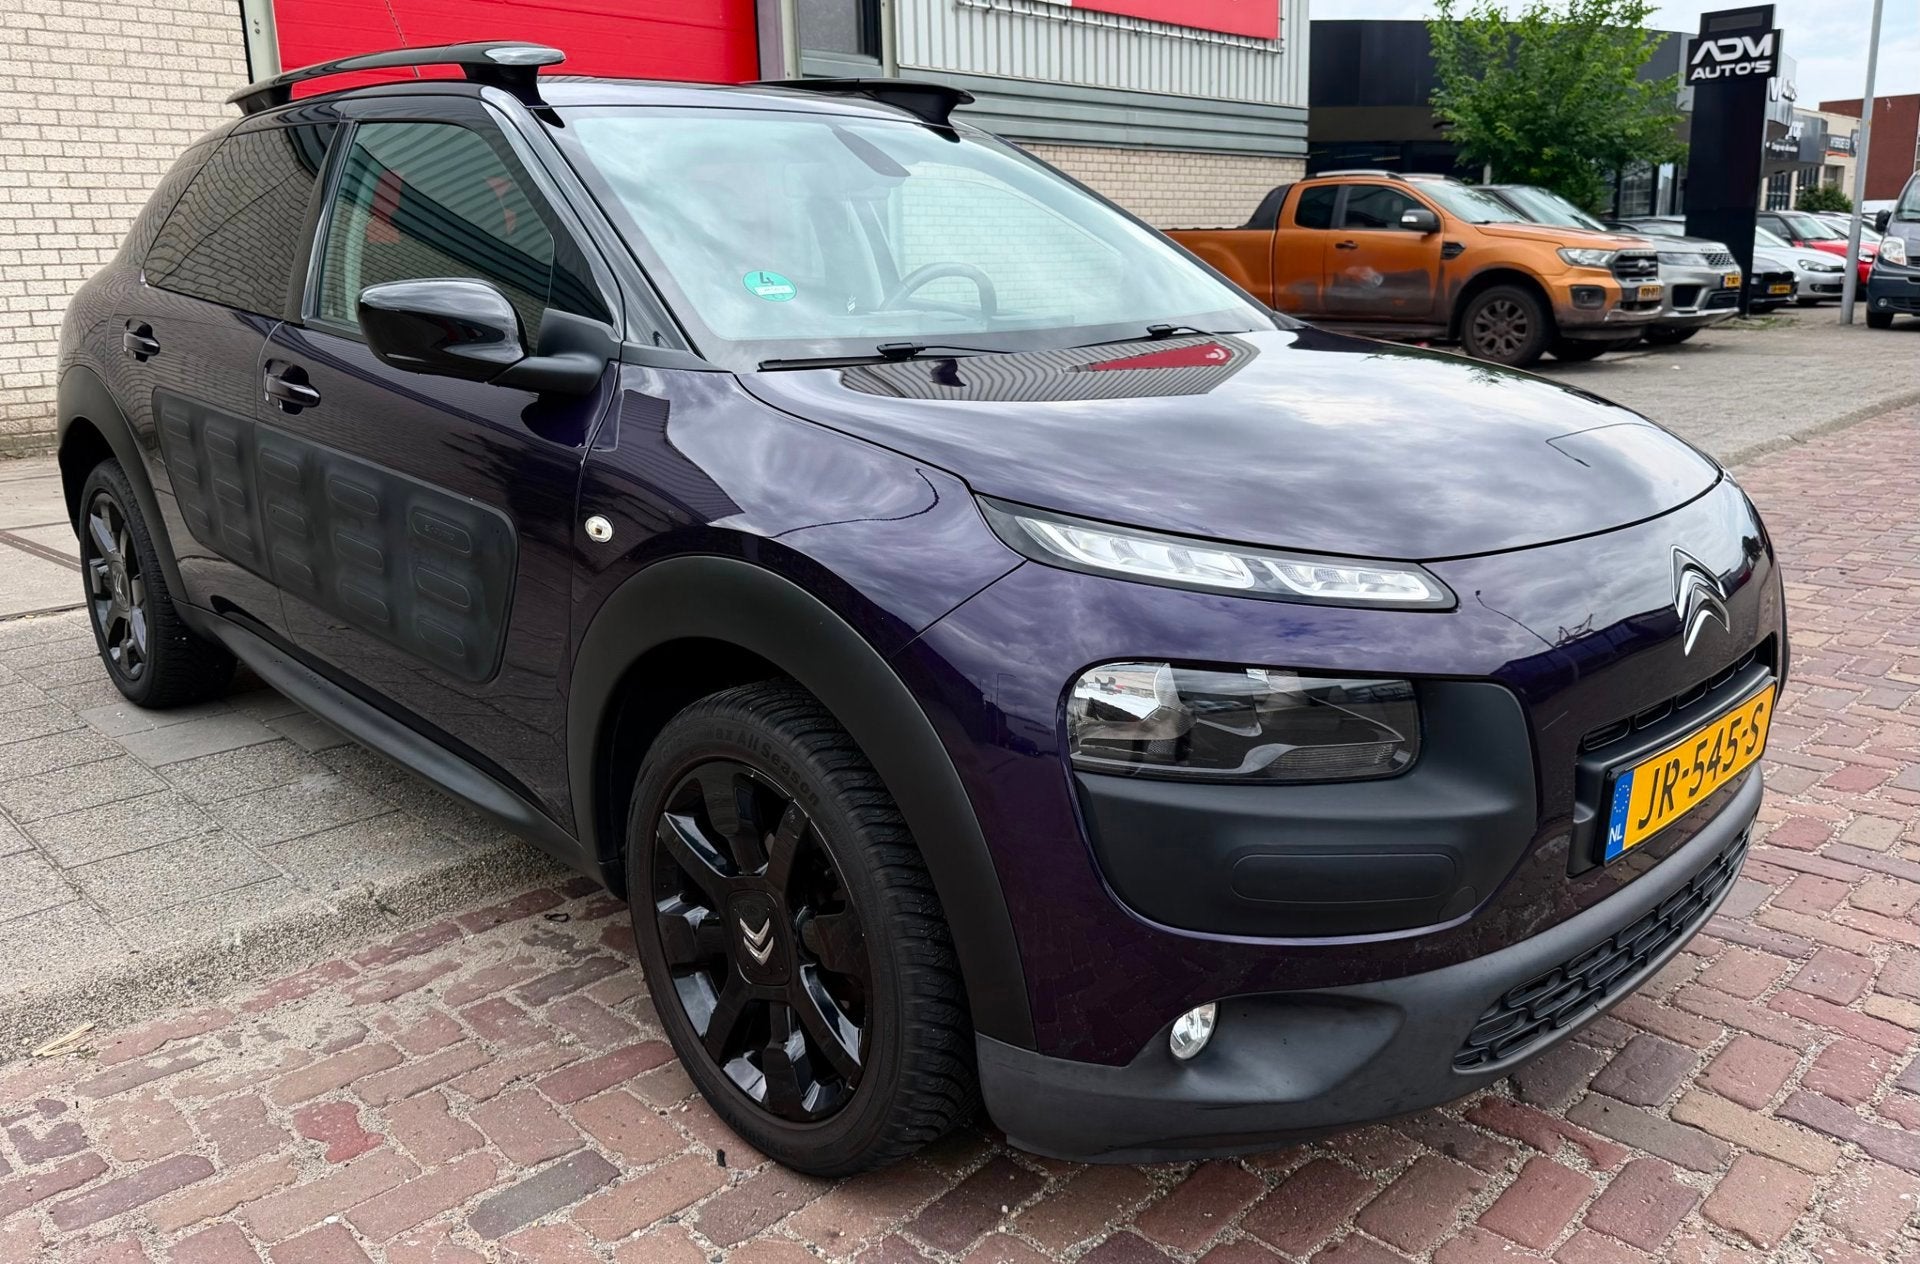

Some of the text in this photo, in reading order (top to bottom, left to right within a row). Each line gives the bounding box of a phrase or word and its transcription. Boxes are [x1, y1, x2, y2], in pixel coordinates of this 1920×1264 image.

[1691, 34, 1773, 65] ADM
[759, 271, 775, 285] 4
[1638, 702, 1764, 830] JR-545-S
[1608, 823, 1623, 845] NL
